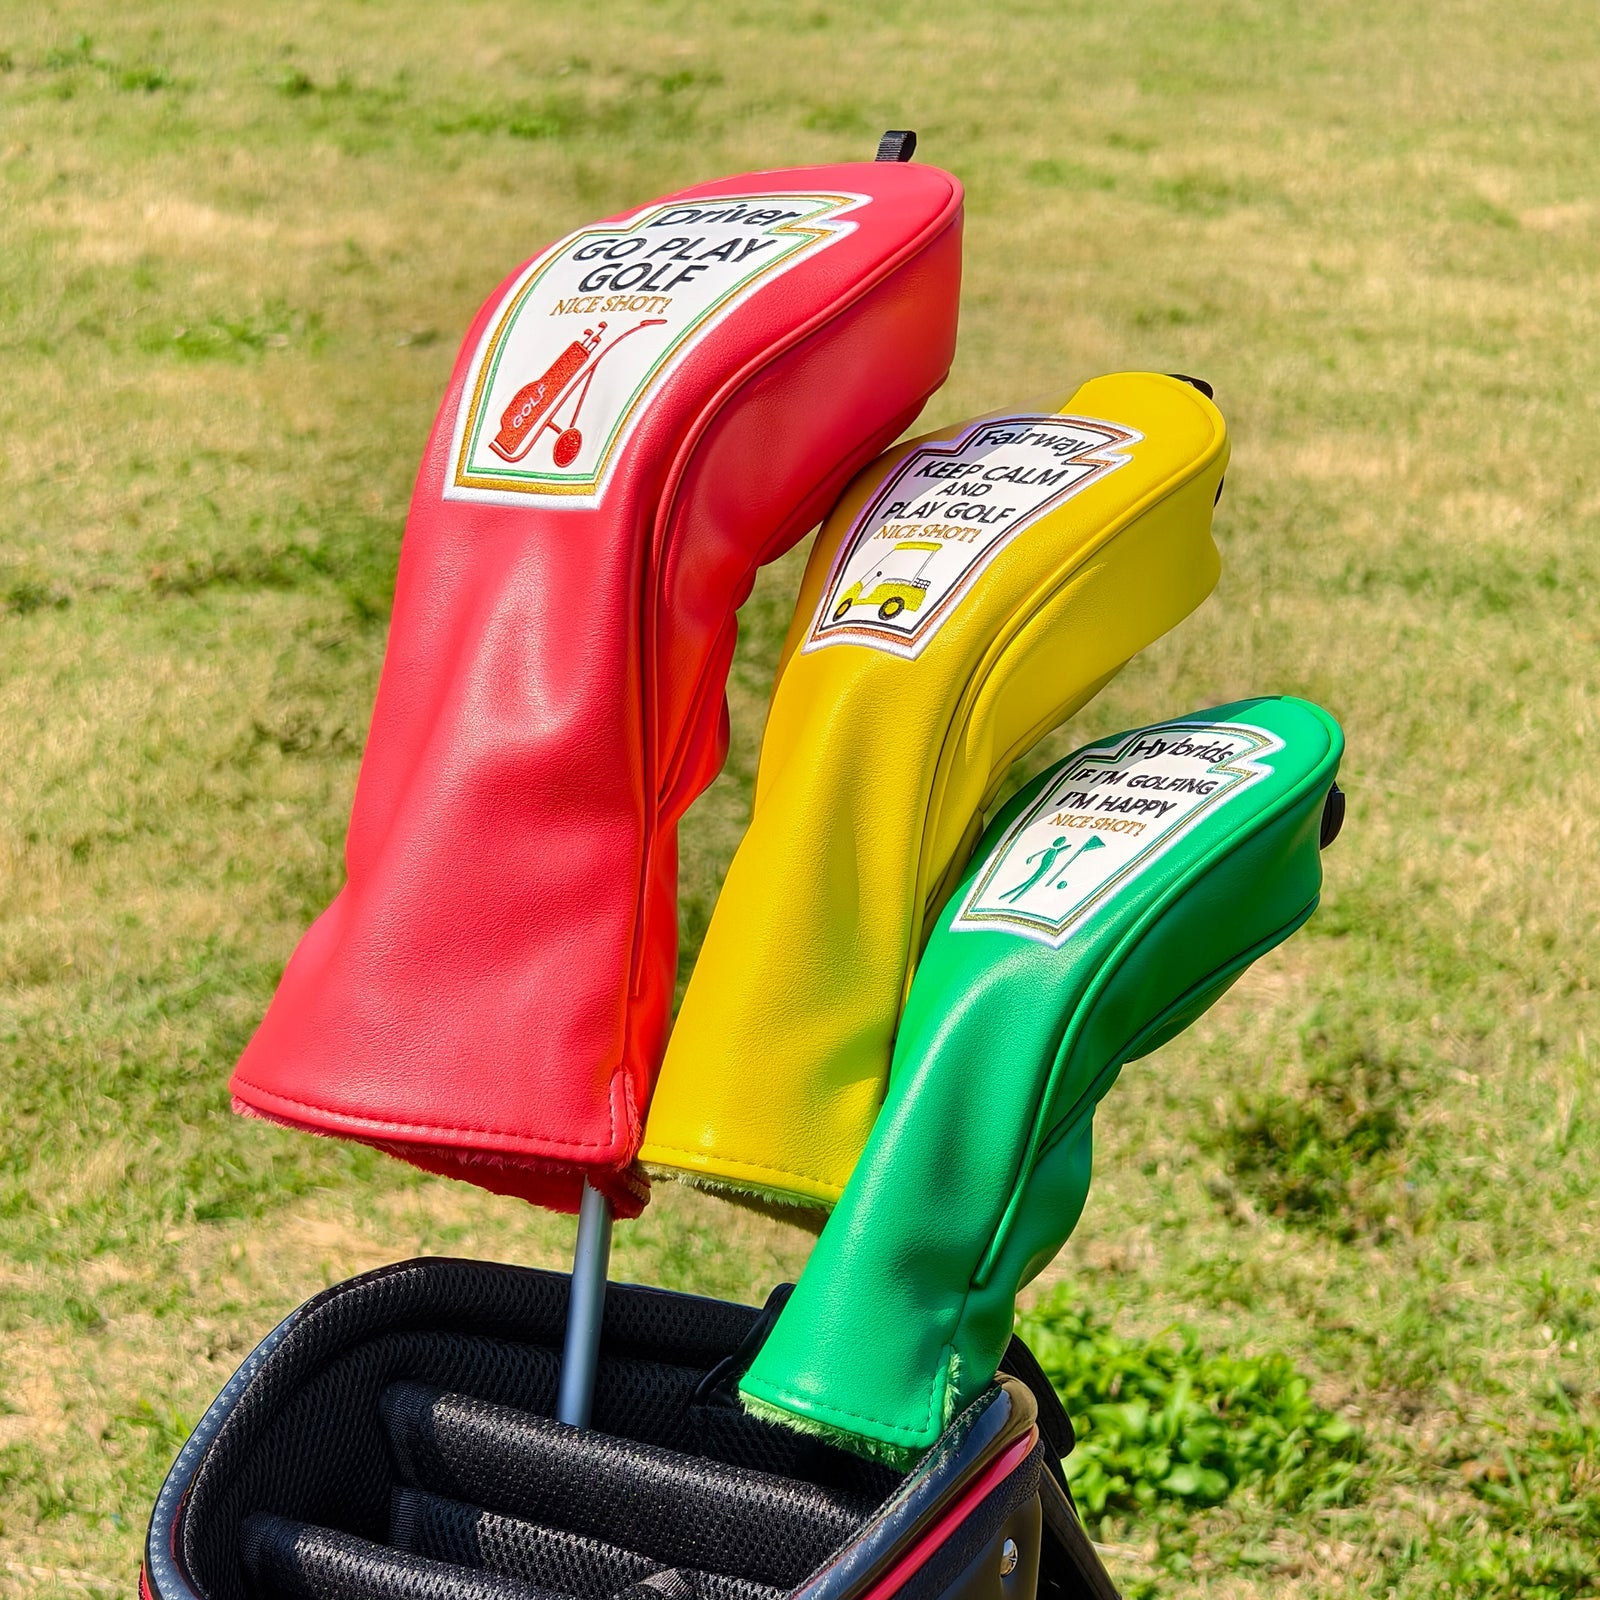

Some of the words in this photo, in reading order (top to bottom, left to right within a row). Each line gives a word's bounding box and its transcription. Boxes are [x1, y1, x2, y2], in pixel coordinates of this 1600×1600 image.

[646, 204, 802, 228] Driver
[572, 238, 647, 261] GO
[644, 237, 778, 263] PLAY
[578, 263, 709, 292] GOLF
[550, 296, 604, 316] NICE
[513, 383, 546, 428] GOLF
[974, 428, 1094, 457] Fairway
[913, 461, 985, 479] KEEP
[982, 466, 1069, 486] CALM
[936, 482, 992, 497] AND
[881, 501, 947, 520] PLAY
[944, 502, 1016, 524] GOLF
[873, 525, 922, 540] NICE
[919, 524, 982, 544] SHOT!
[1128, 737, 1234, 763] Hybrids
[1070, 768, 1097, 783] IF
[1091, 769, 1129, 785] I'M
[1127, 774, 1219, 795] GOLFING
[1056, 791, 1099, 809] I'M
[1095, 795, 1177, 819] HAPPY
[1048, 813, 1094, 828] NICE
[1090, 817, 1147, 837] SHOT!
